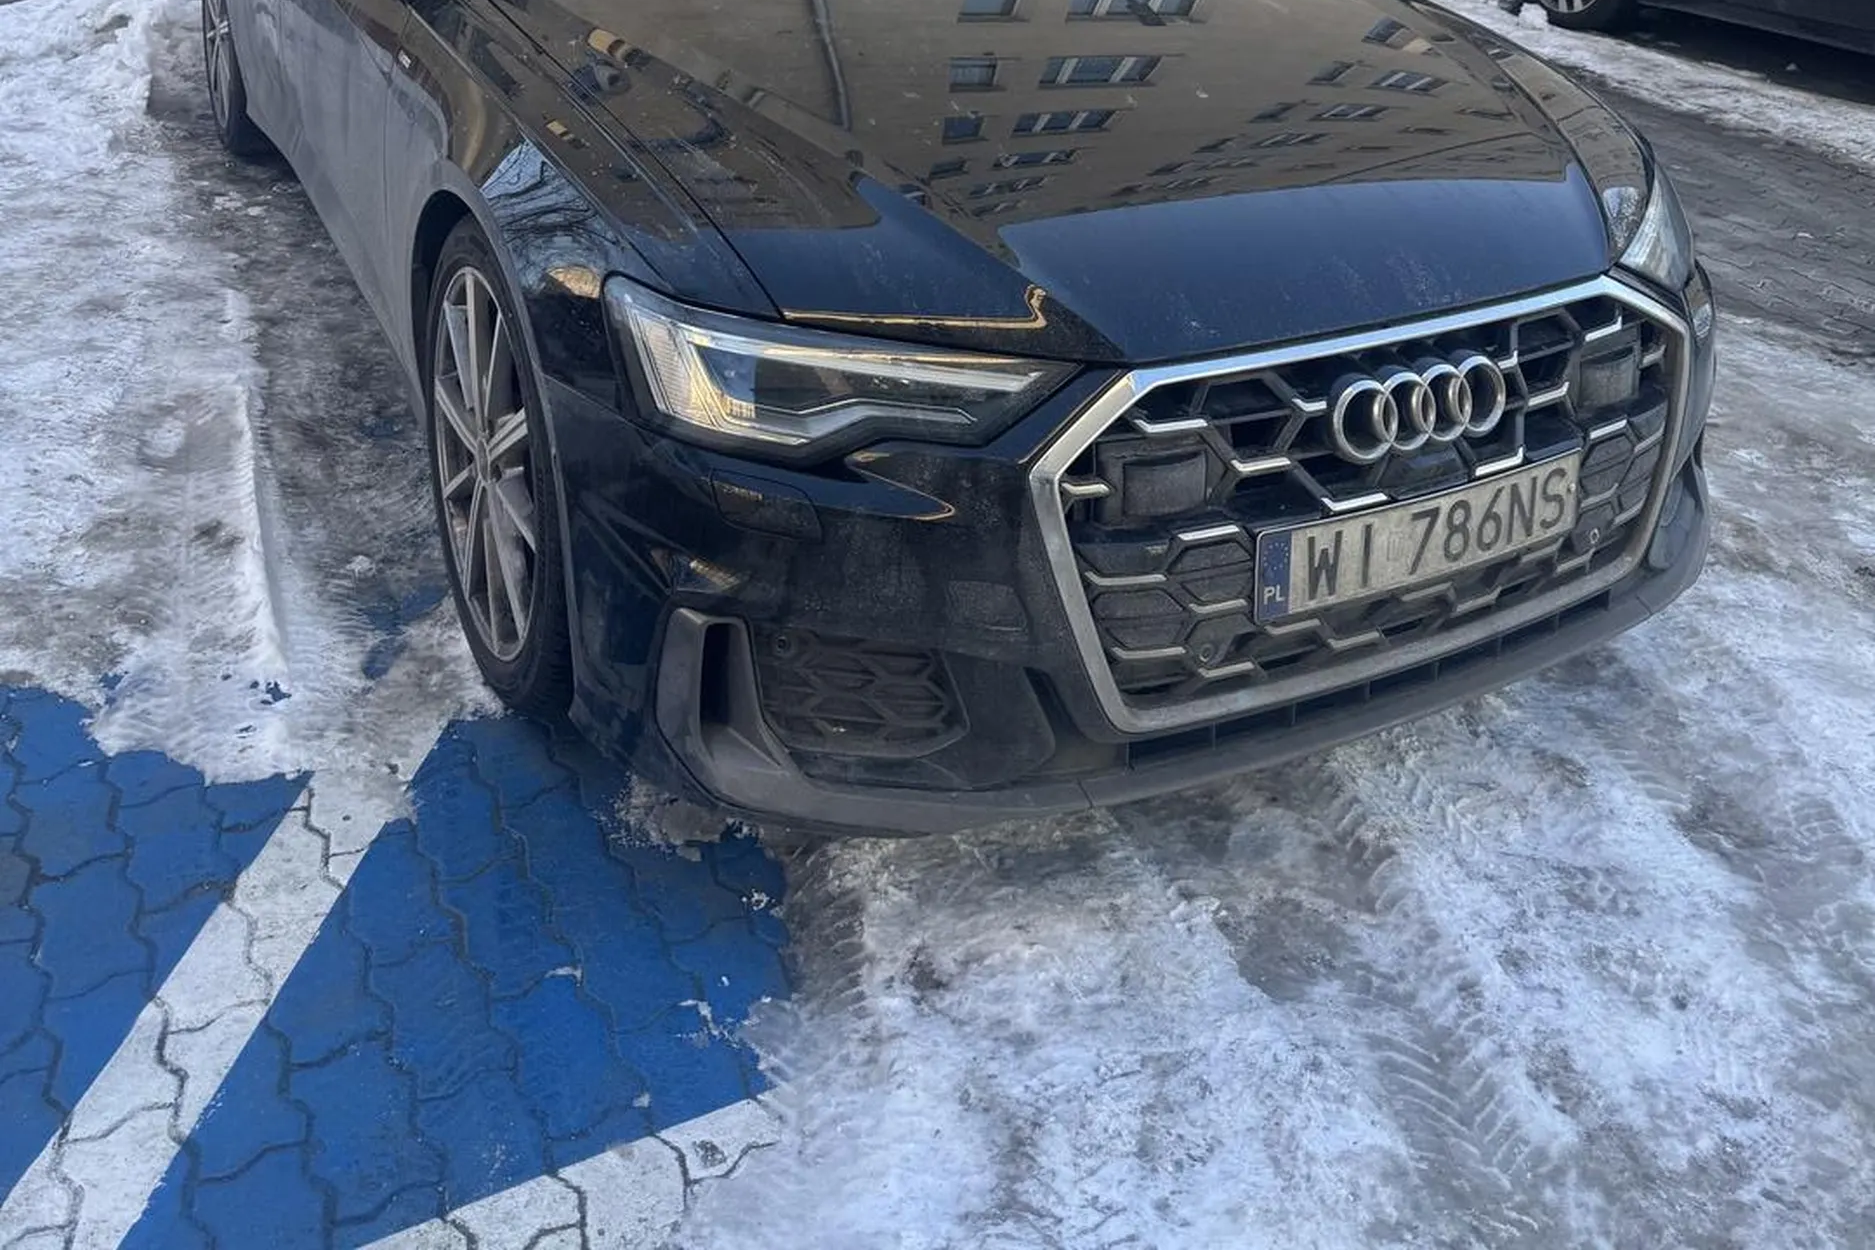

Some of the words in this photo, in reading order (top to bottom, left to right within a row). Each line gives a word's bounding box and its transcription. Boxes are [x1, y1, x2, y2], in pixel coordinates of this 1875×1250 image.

[1306, 522, 1374, 602] WI
[1408, 467, 1569, 576] 786NS
[1263, 586, 1286, 606] PL
